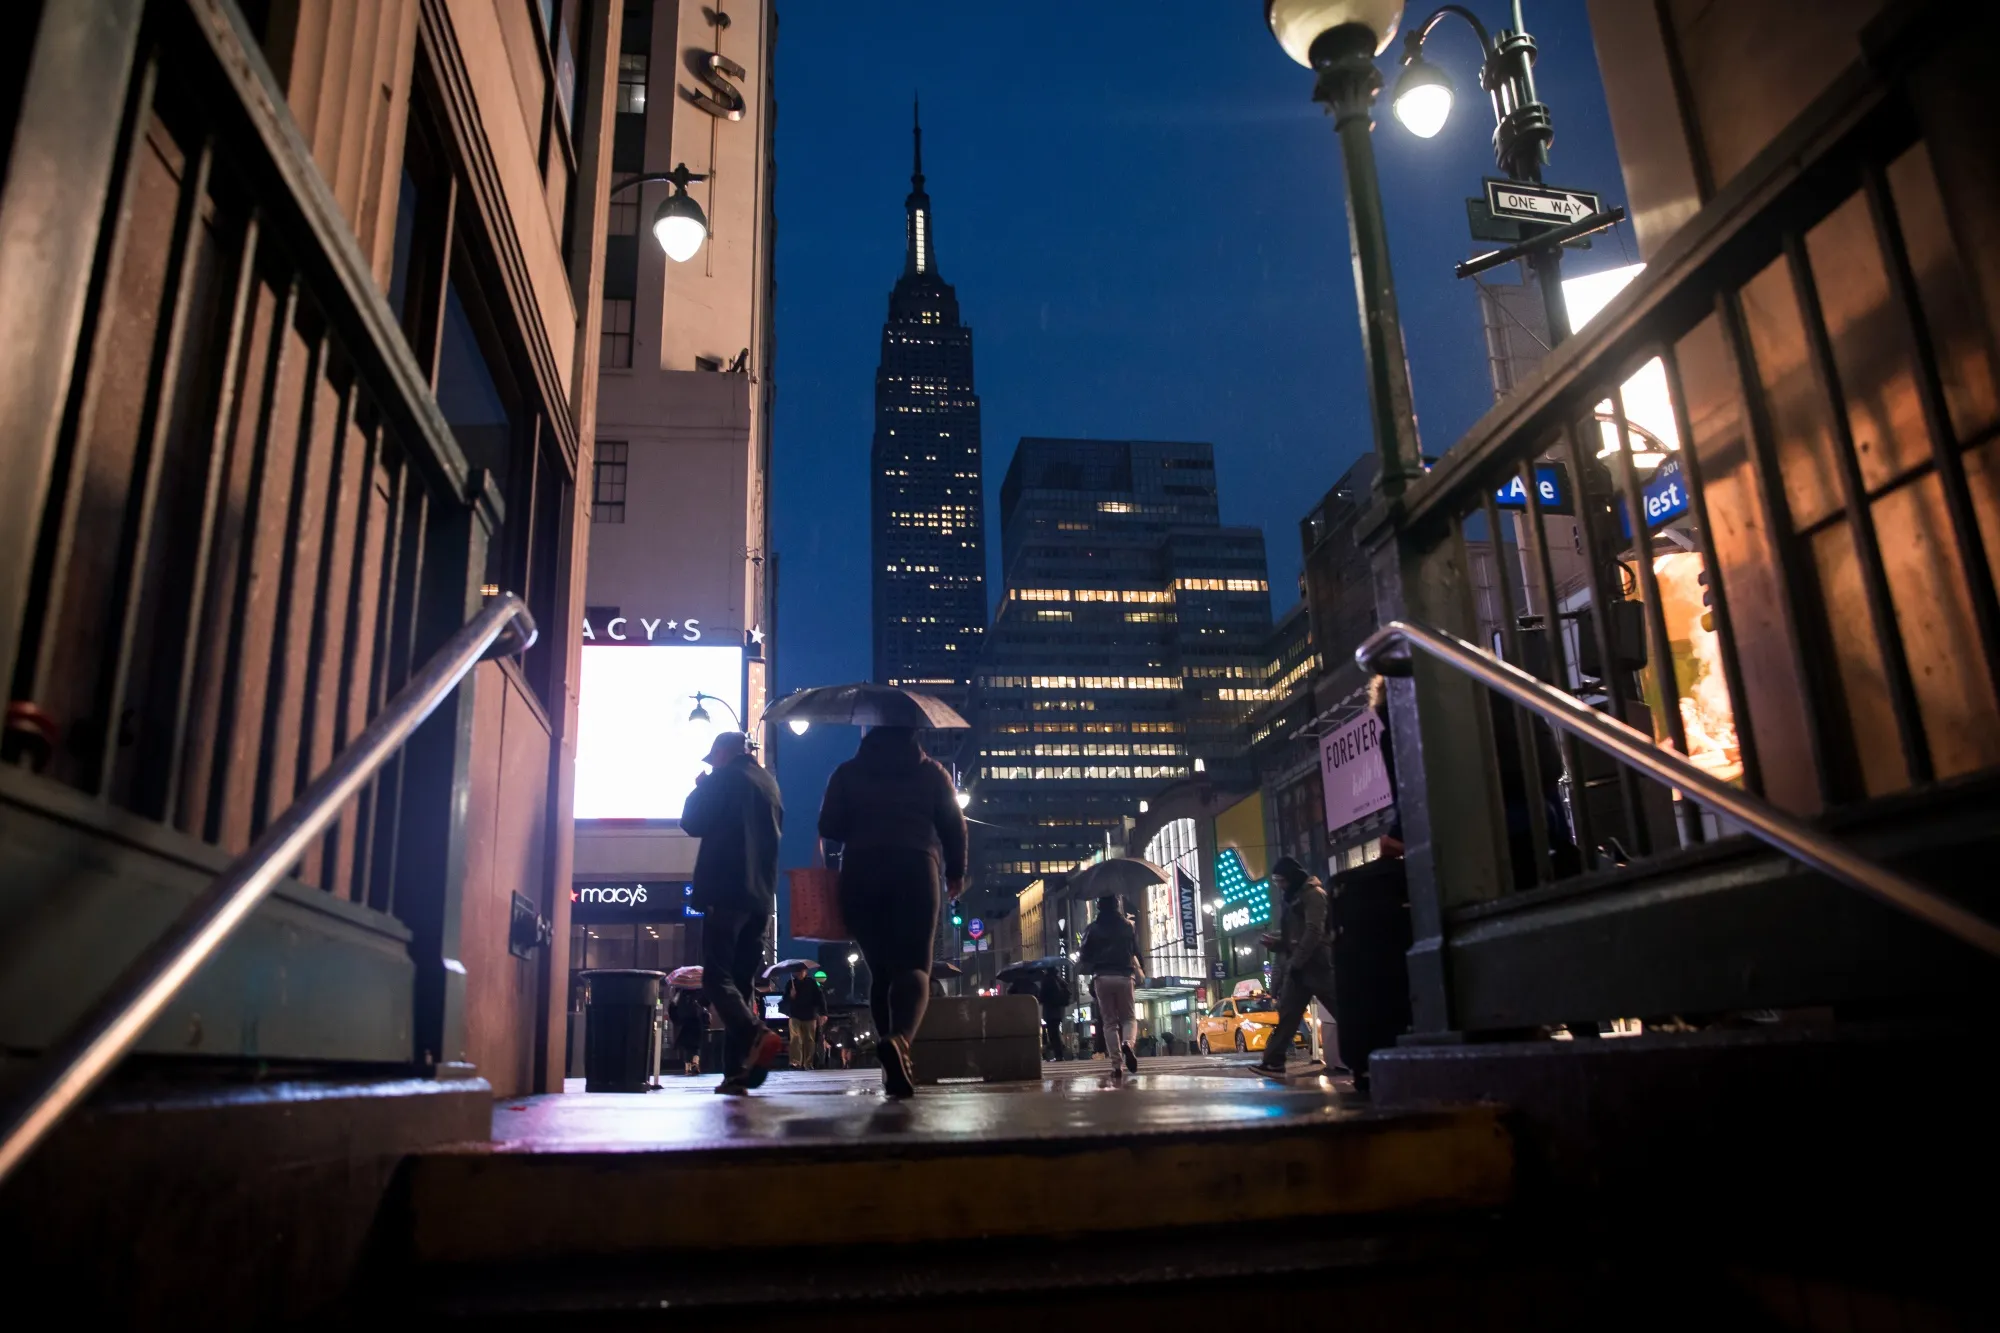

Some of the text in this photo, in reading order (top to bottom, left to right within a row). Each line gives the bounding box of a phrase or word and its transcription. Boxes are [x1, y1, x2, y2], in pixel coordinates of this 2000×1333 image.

[1508, 195, 1537, 210] ONE
[1551, 201, 1582, 216] WAY
[1510, 475, 1555, 499] Ae
[1643, 482, 1681, 521] est
[1325, 718, 1378, 773] FOREVER
[581, 884, 647, 906] macy's
[1181, 888, 1195, 944] OLD NAVY
[1222, 907, 1250, 931] crocs
